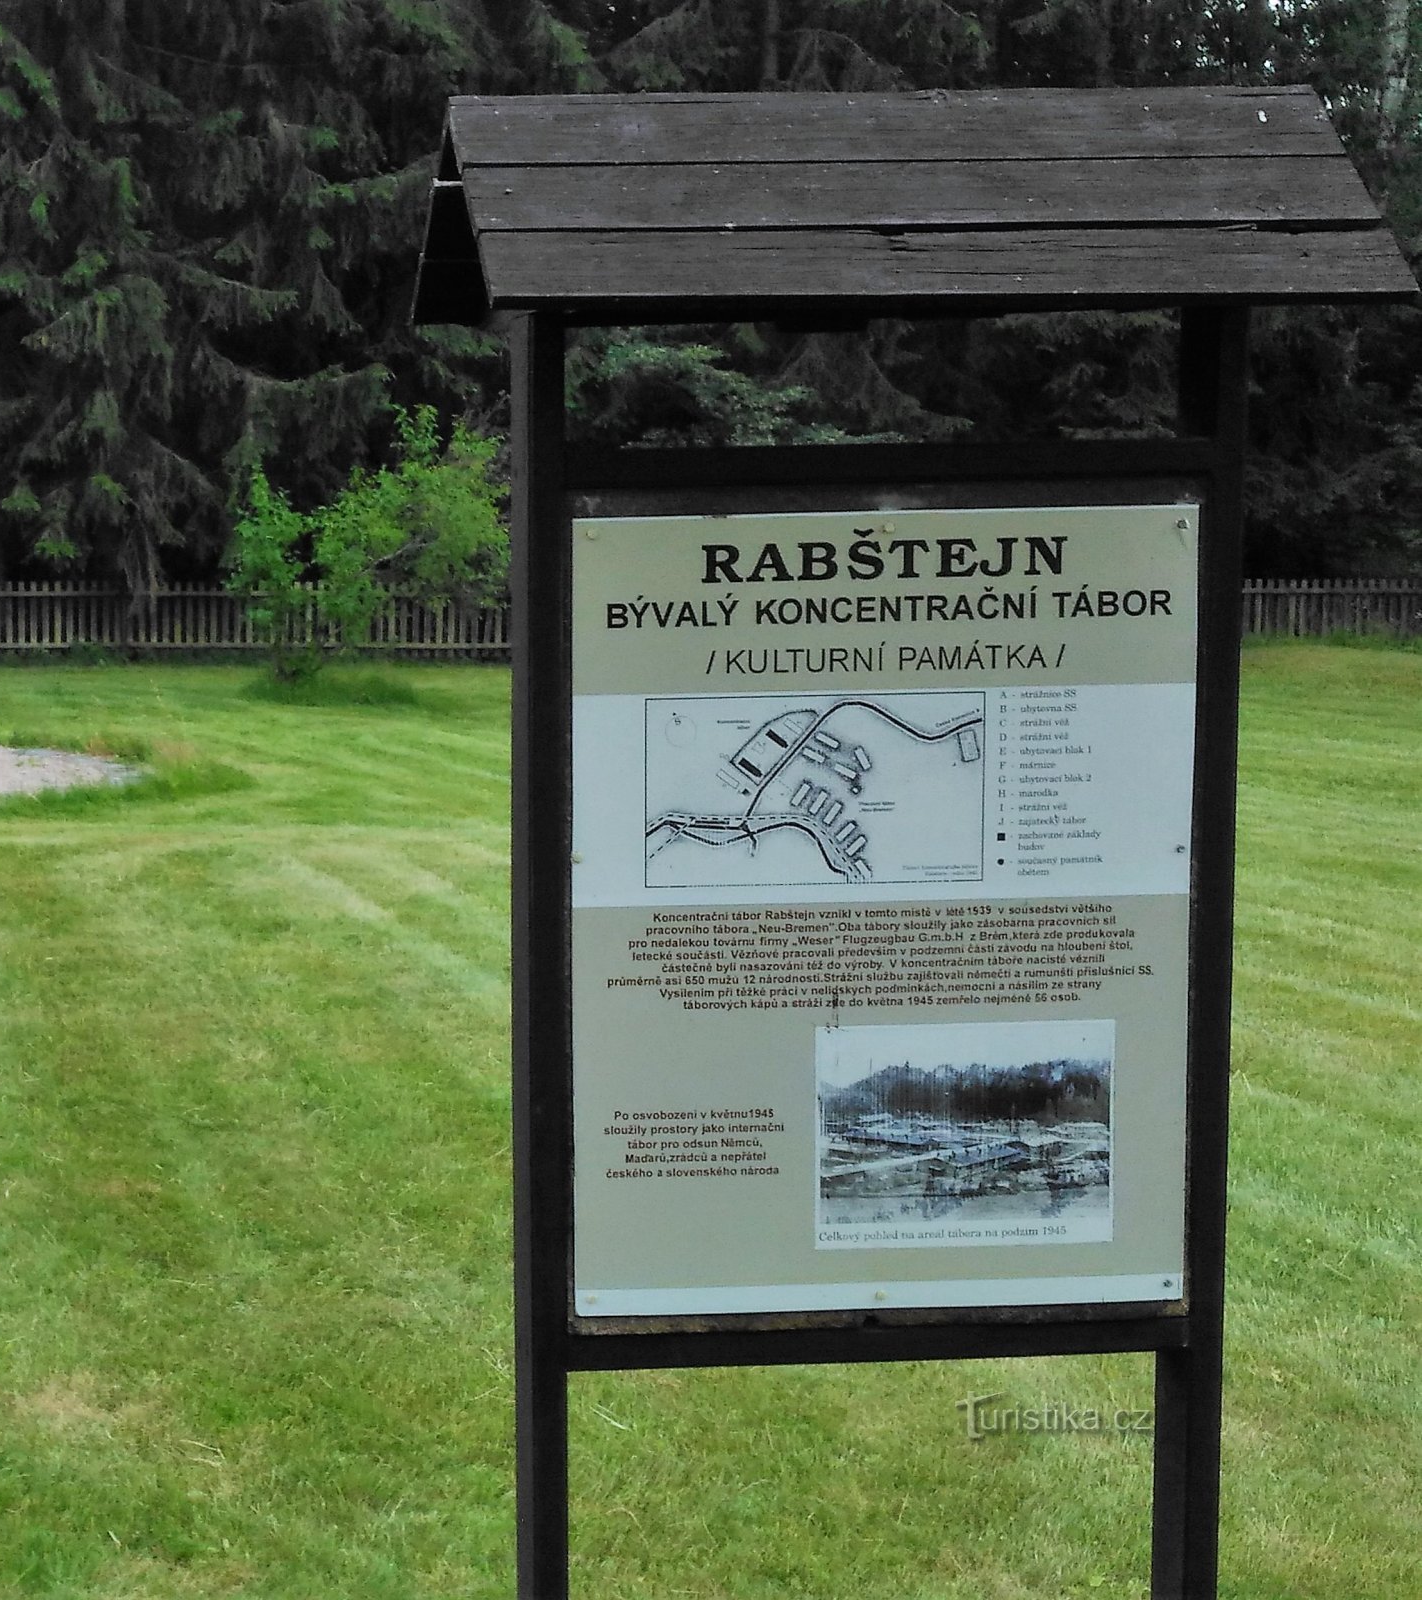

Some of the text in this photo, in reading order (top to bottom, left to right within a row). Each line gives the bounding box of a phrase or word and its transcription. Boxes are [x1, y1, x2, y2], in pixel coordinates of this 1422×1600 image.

[701, 528, 1068, 584] RABŠTEJN
[607, 586, 1172, 628] BÝVALÝ KONCENTRAČNÍ TÁBOR
[726, 644, 885, 673] KULTURNÍ
[900, 642, 1047, 670] PAMÁTKA
[732, 912, 761, 921] tábor
[766, 910, 815, 921] Rabštejn
[819, 910, 851, 919] vznikl
[865, 909, 898, 918] tomto
[646, 925, 709, 936] pracovního
[865, 922, 900, 932] tábory
[950, 919, 973, 930] jako
[977, 919, 1034, 928] zásobarna
[629, 941, 648, 950] pro
[652, 938, 709, 948] nedalekou
[714, 938, 754, 946] továrnu
[760, 937, 788, 947] firmy
[843, 935, 914, 945] Flugzeugbau
[1066, 929, 1134, 940] produkovala
[633, 951, 672, 961] letecké
[783, 947, 834, 959] pracovali
[998, 944, 1037, 953] závodu
[716, 962, 736, 974] byli
[807, 960, 823, 970] též
[827, 958, 841, 970] do
[890, 959, 897, 968] V
[1027, 954, 1066, 964] nacisté
[665, 976, 682, 985] asi
[685, 976, 705, 985] 650
[744, 975, 756, 984] 12
[866, 970, 903, 981] službu
[718, 988, 733, 999] při
[736, 987, 766, 997] těžké
[1068, 981, 1102, 990] strany
[684, 999, 747, 1010] táborových
[751, 997, 778, 1010] kápů
[849, 995, 863, 1007] do
[868, 995, 903, 1006] května
[908, 996, 933, 1005] 1945
[936, 995, 981, 1005] zemřelo
[1051, 993, 1081, 1002] osob.
[614, 1111, 629, 1120] Po
[651, 1126, 698, 1136] prostory
[702, 1124, 725, 1135] jako
[628, 1140, 658, 1149] tábor
[661, 1141, 679, 1151] pro
[683, 1139, 718, 1148] odsun
[711, 1154, 717, 1162] a
[721, 1152, 766, 1162] nepřátel
[606, 1169, 653, 1178] českého
[666, 1167, 737, 1177] slovenského
[741, 1166, 779, 1175] národa
[1043, 1226, 1066, 1235] 1945
